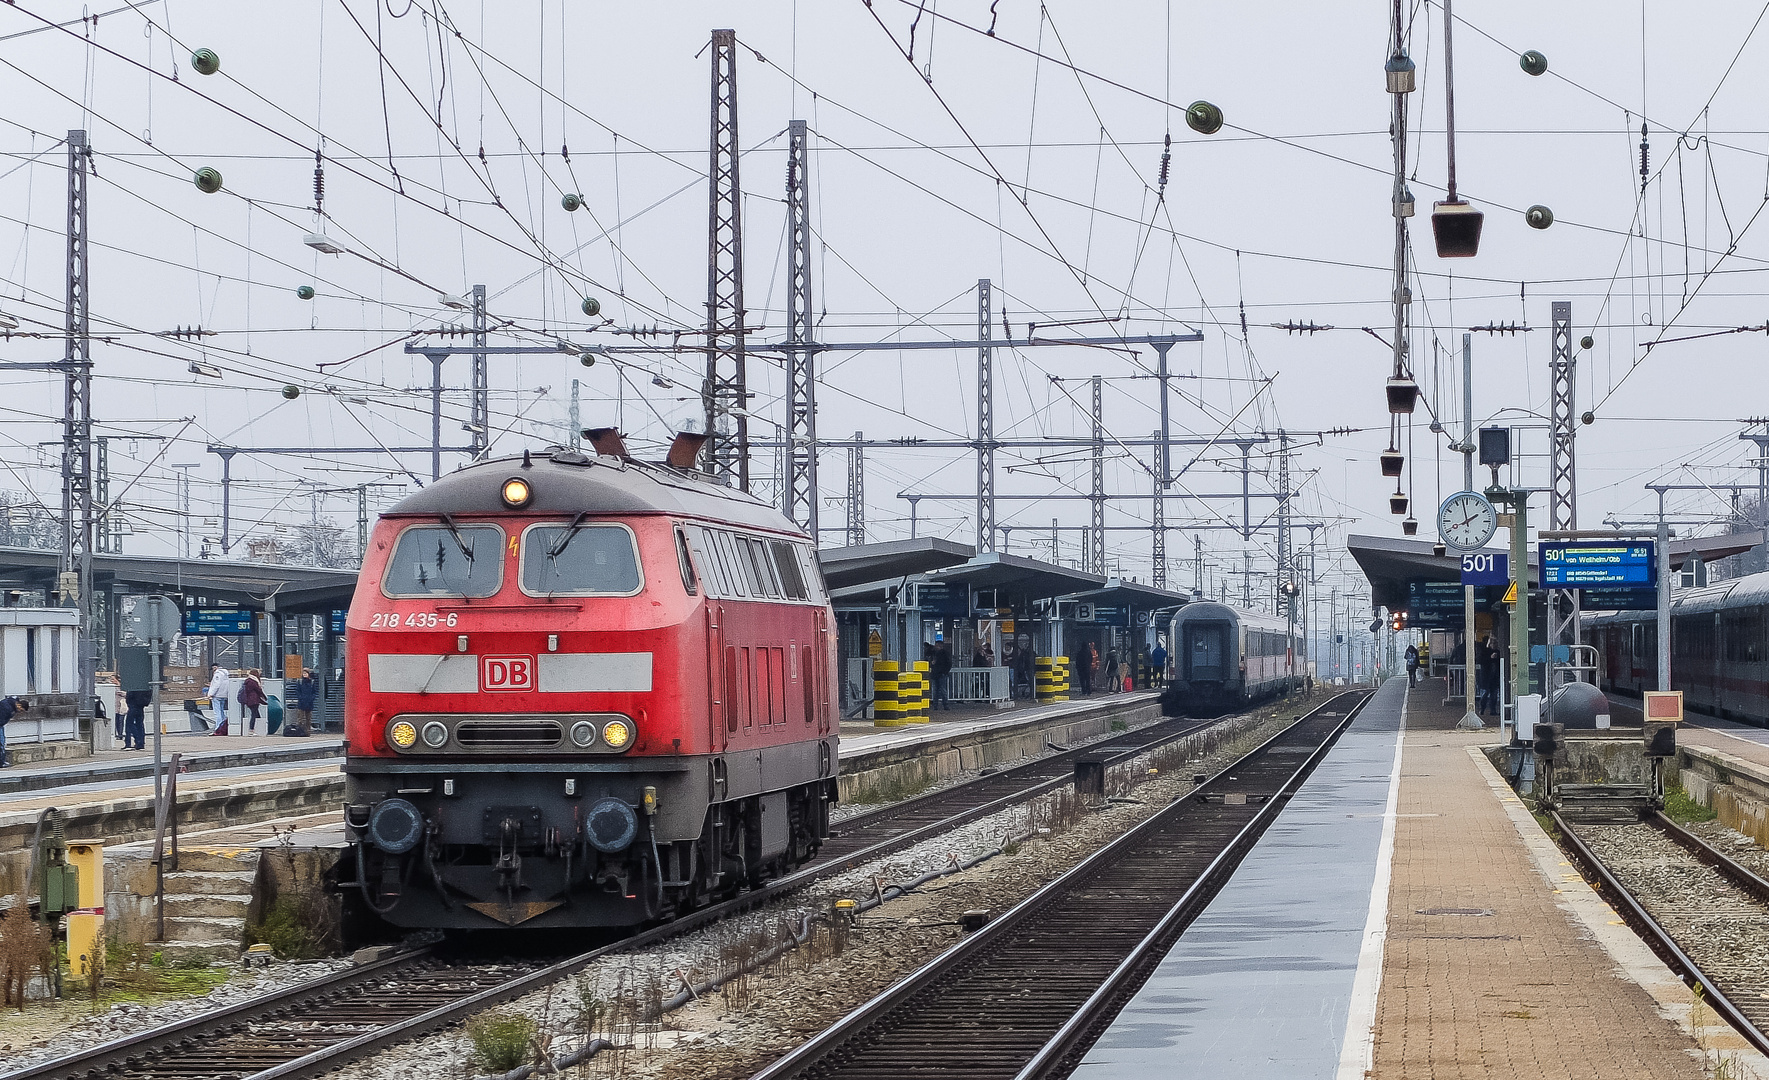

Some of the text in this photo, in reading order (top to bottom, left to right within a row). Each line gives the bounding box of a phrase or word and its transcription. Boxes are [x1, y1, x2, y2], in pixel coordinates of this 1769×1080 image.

[1545, 549, 1564, 561] 501
[1462, 554, 1494, 572] 501
[1080, 606, 1090, 618] B
[1138, 613, 1148, 623] C
[370, 612, 458, 628] 218 435-6
[488, 661, 528, 686] DB
